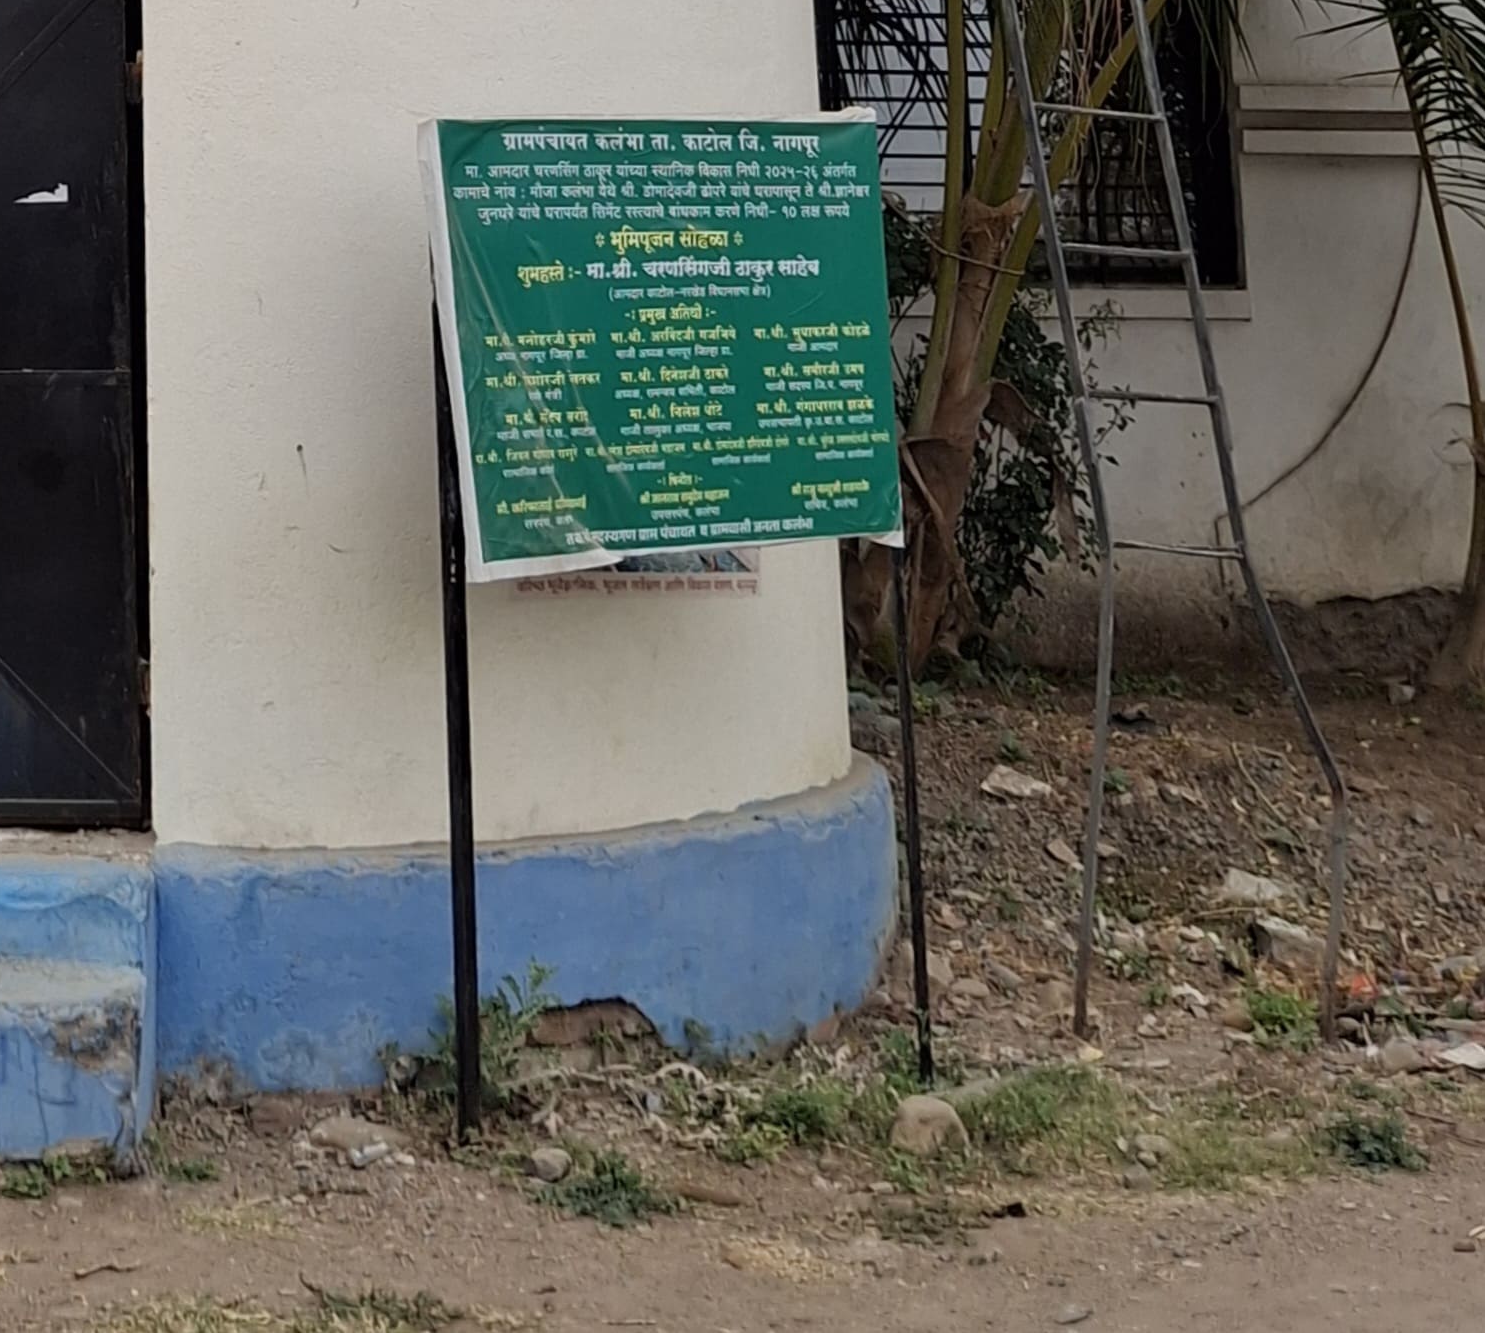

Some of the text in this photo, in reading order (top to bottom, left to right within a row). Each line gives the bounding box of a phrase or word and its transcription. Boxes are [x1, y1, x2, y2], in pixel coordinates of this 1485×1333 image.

[501, 126, 820, 158] ग्रामपंचायत कलंभा ता. काटोल जि. नागपूर
[488, 164, 530, 179] आमदार
[616, 161, 647, 178] यांच्या
[651, 161, 695, 178] स्थानिक
[698, 161, 733, 178] विकास
[736, 161, 761, 178] निधी
[822, 162, 857, 179] अंतर्गत
[452, 182, 490, 200] कामाचे
[529, 182, 558, 199] मौजा
[561, 182, 595, 199] कलंभा
[679, 224, 729, 249] सोहळा
[642, 256, 731, 278] चरणसिंगजी
[777, 254, 820, 276] साहेब
[639, 307, 666, 323] प्रमुख
